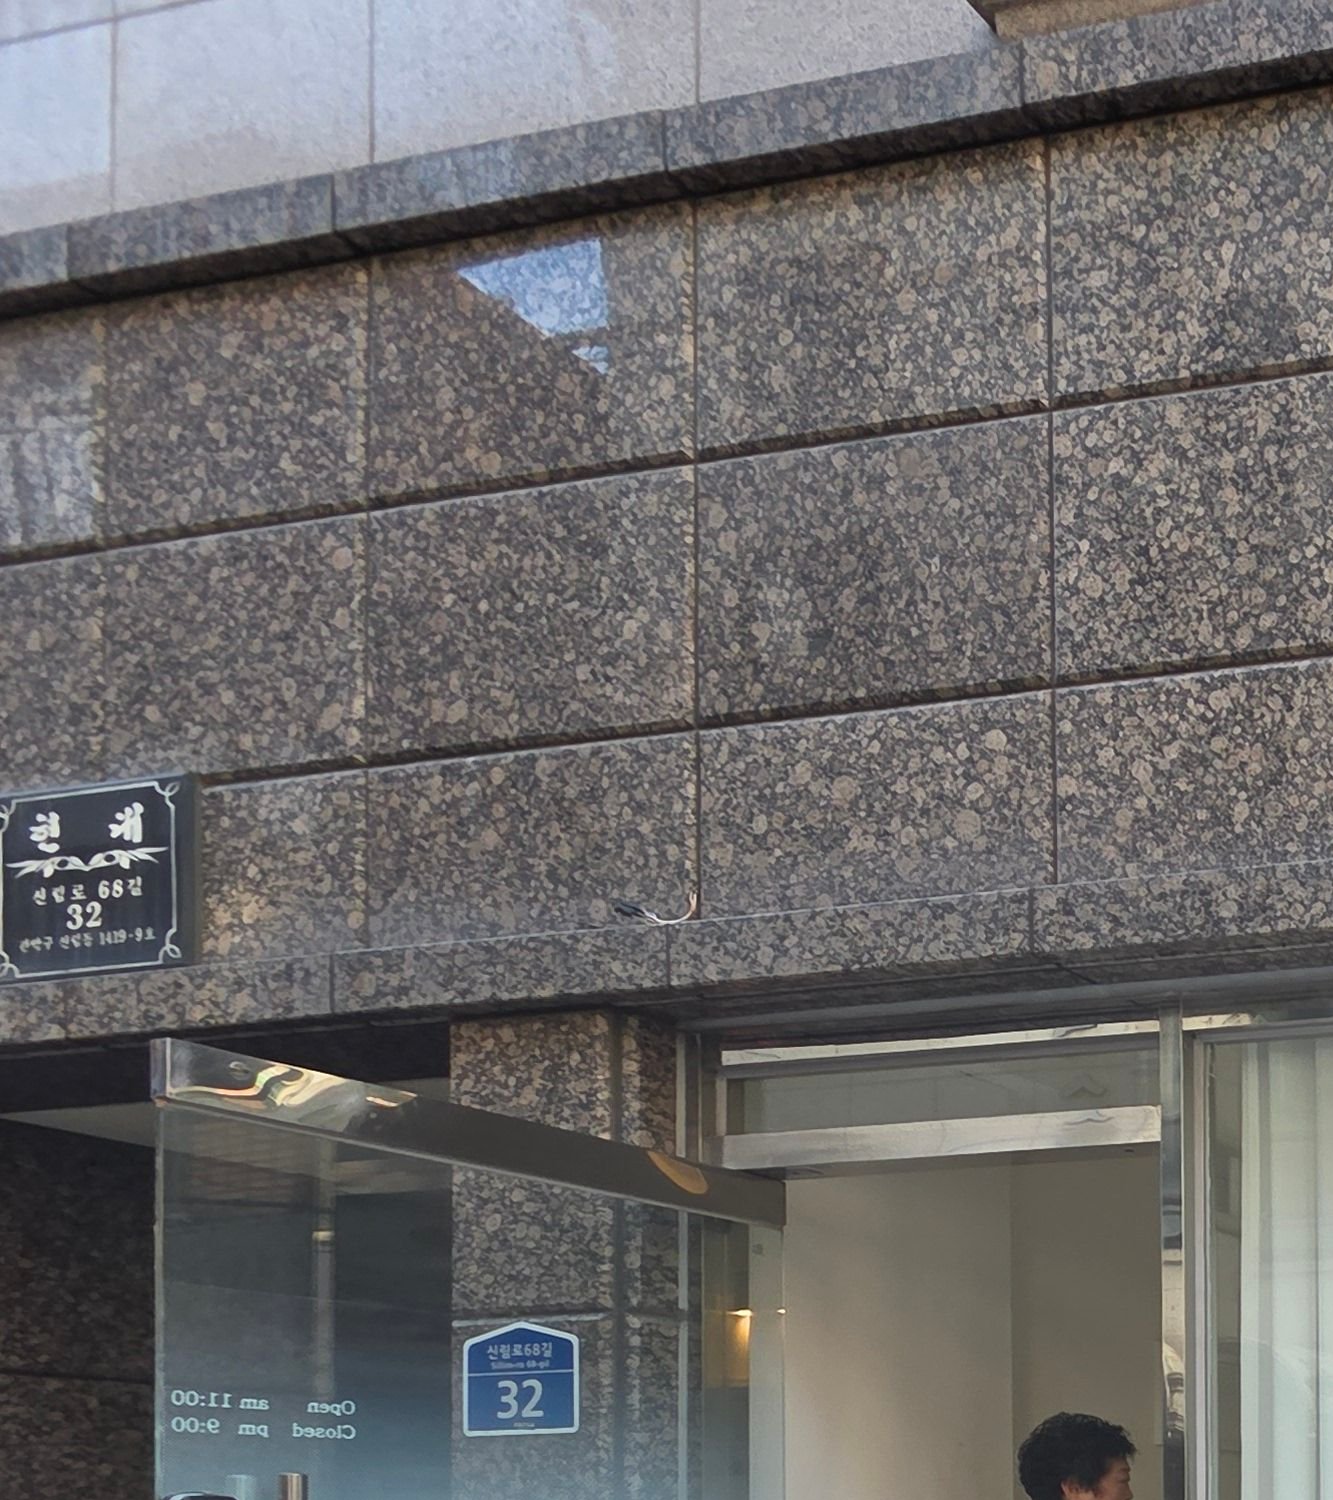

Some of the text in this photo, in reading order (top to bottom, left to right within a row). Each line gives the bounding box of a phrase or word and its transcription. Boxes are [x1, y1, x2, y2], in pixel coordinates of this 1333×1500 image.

[66, 901, 102, 930] 32
[487, 1342, 553, 1360] 신림로68길
[497, 1378, 544, 1419] 32
